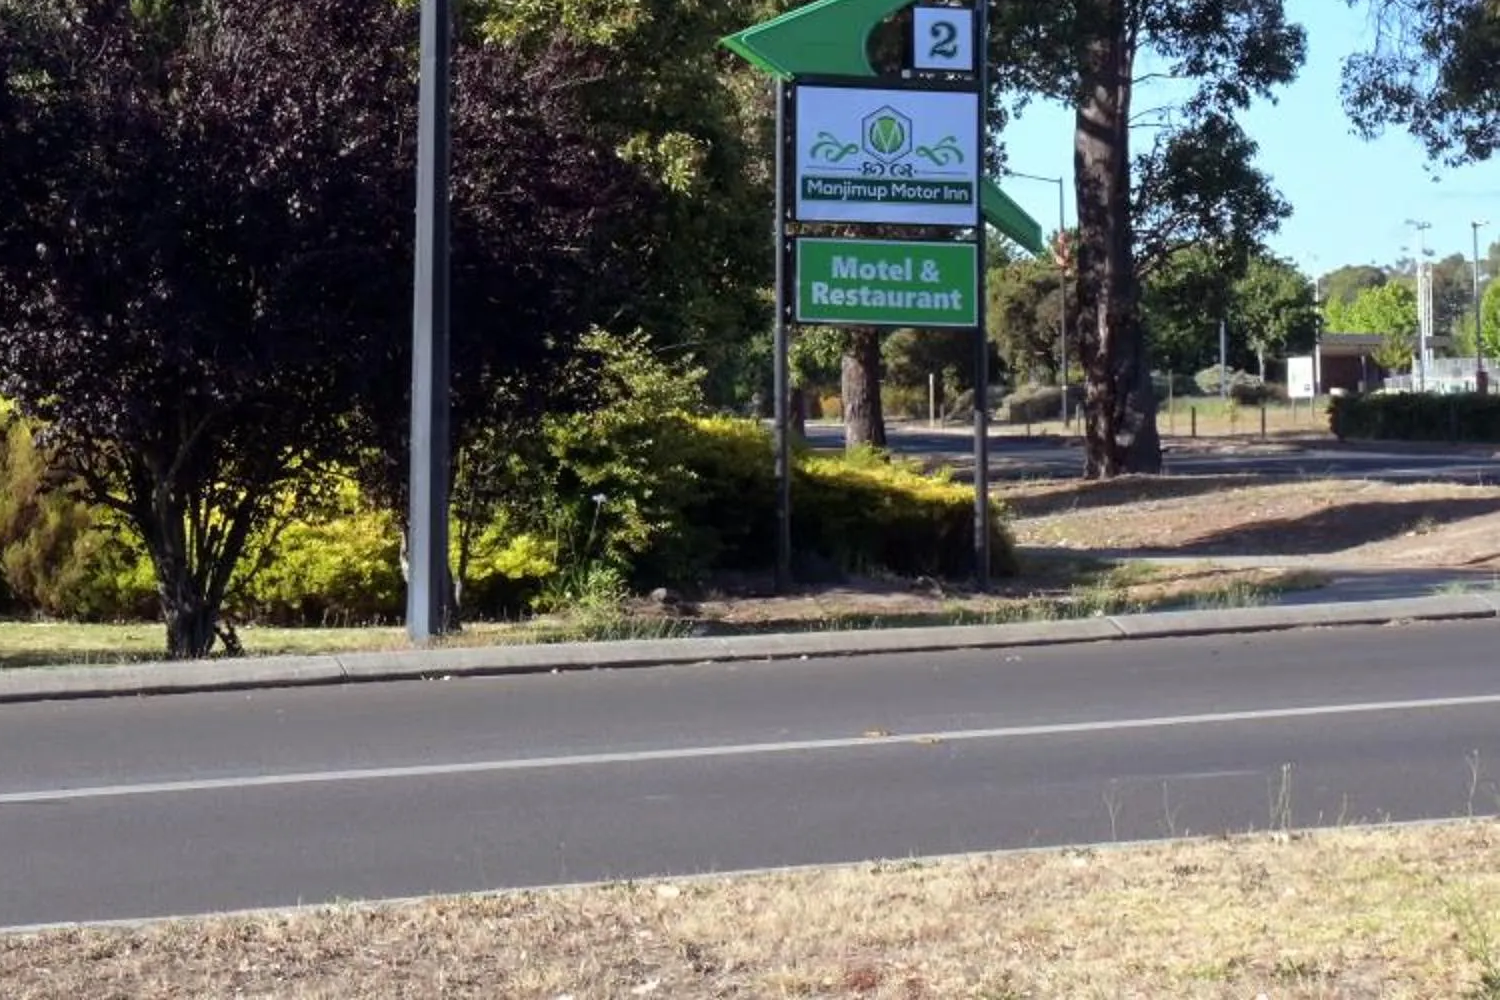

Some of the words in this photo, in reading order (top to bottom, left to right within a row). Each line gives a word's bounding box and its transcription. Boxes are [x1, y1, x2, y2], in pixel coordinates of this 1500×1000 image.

[929, 21, 957, 59] 2
[807, 179, 888, 201] Manjimup
[891, 183, 941, 199] Motor
[943, 185, 969, 201] Inn
[831, 255, 913, 282] Motel
[919, 259, 940, 283] &
[811, 281, 963, 311] Restaurant
